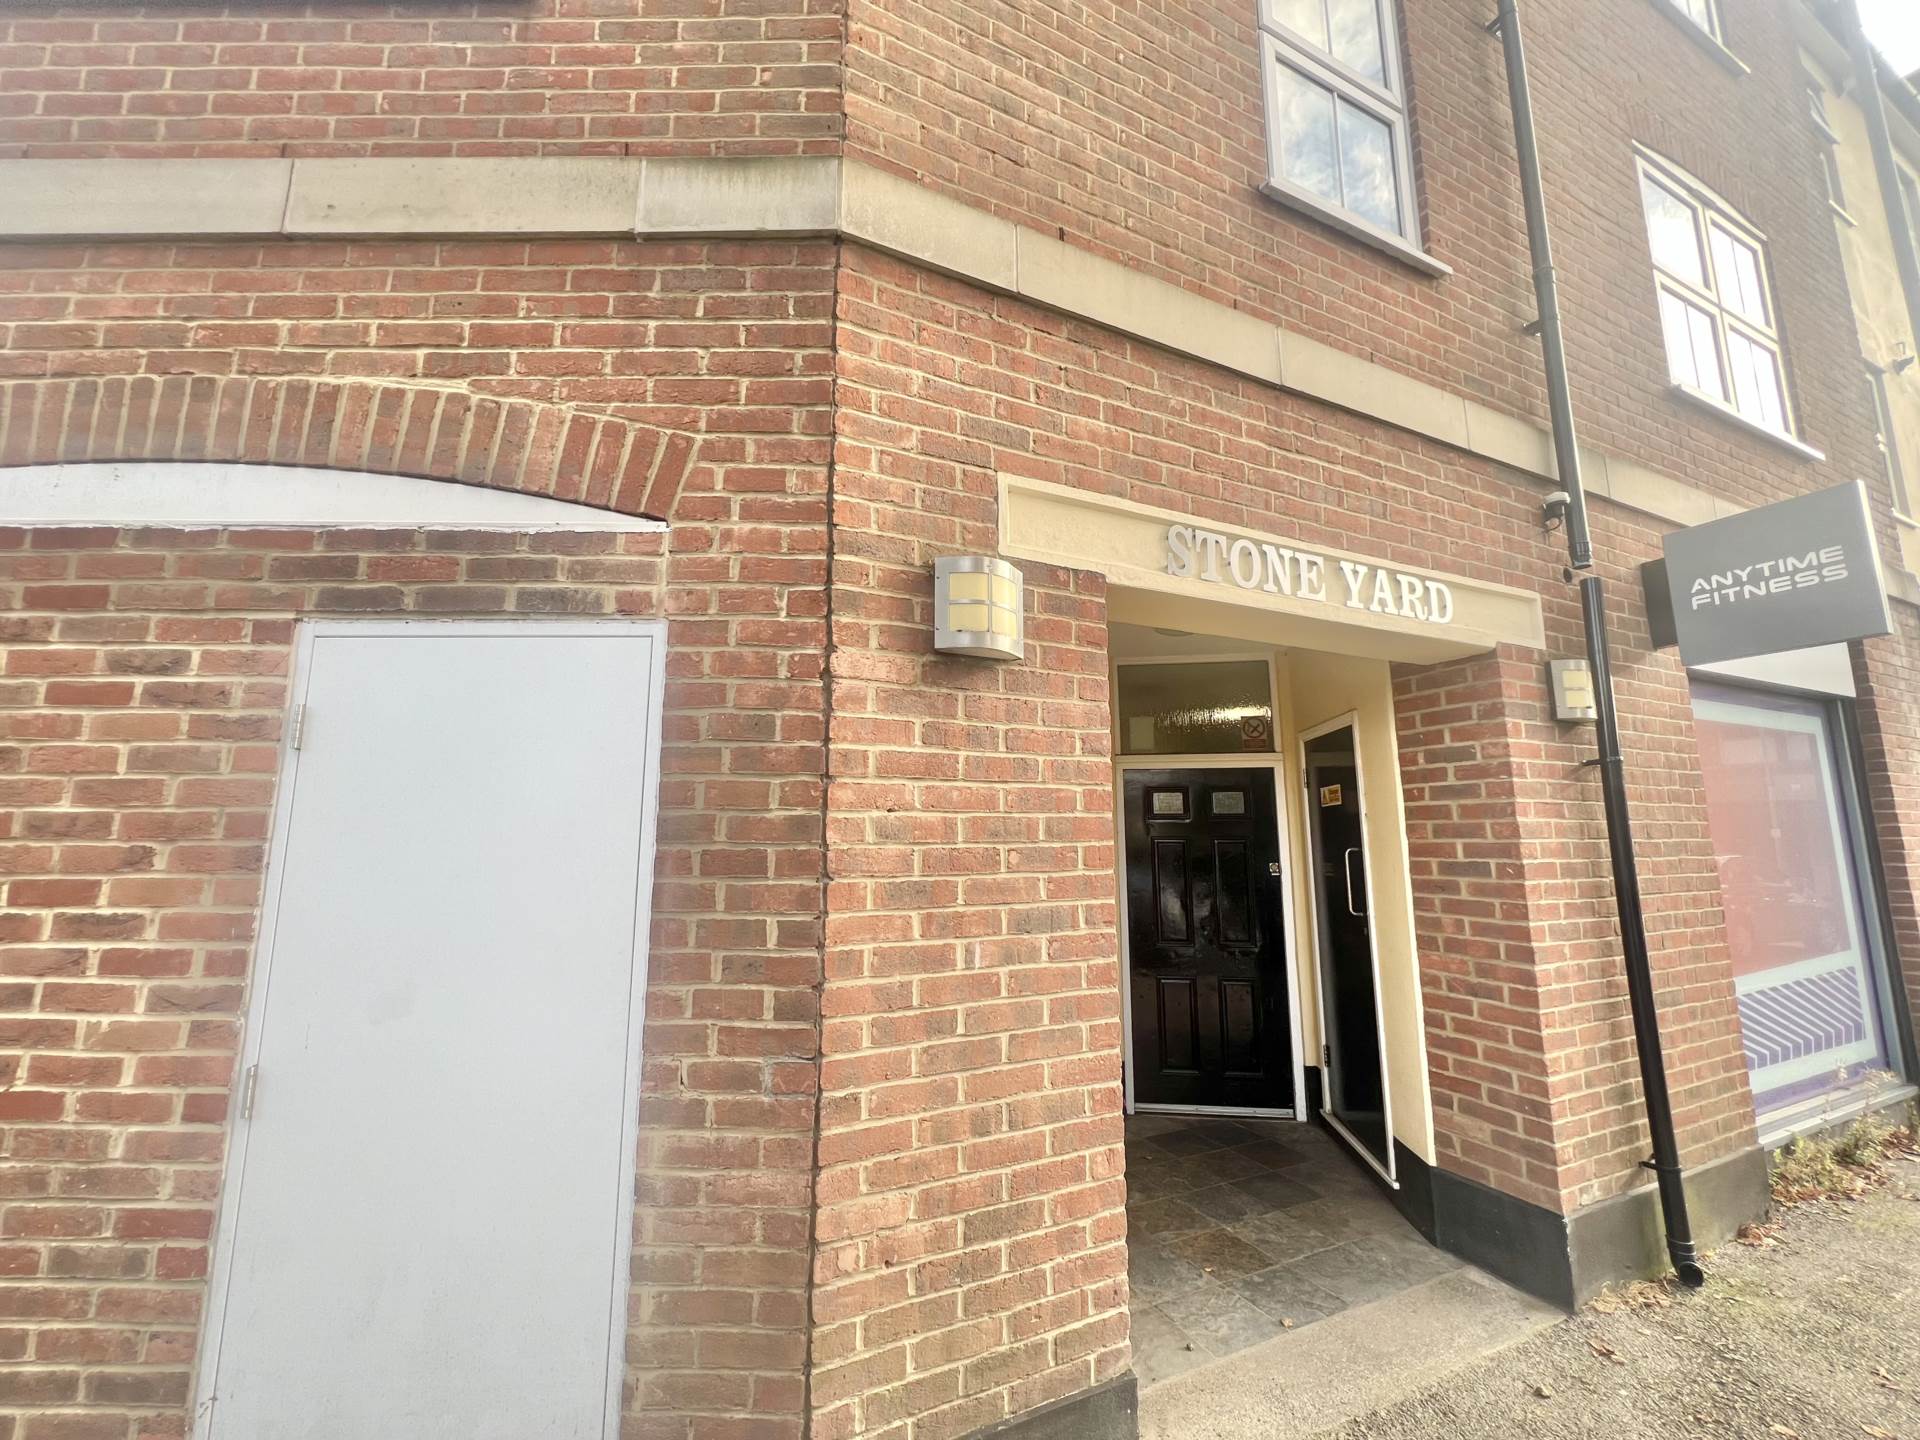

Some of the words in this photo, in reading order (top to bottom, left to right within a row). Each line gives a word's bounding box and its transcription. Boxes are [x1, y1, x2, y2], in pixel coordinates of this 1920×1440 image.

[1166, 524, 1326, 601] STONE
[1339, 560, 1455, 624] YARD
[1690, 545, 1845, 594] ANYTIME
[1690, 563, 1849, 610] FITNESS
